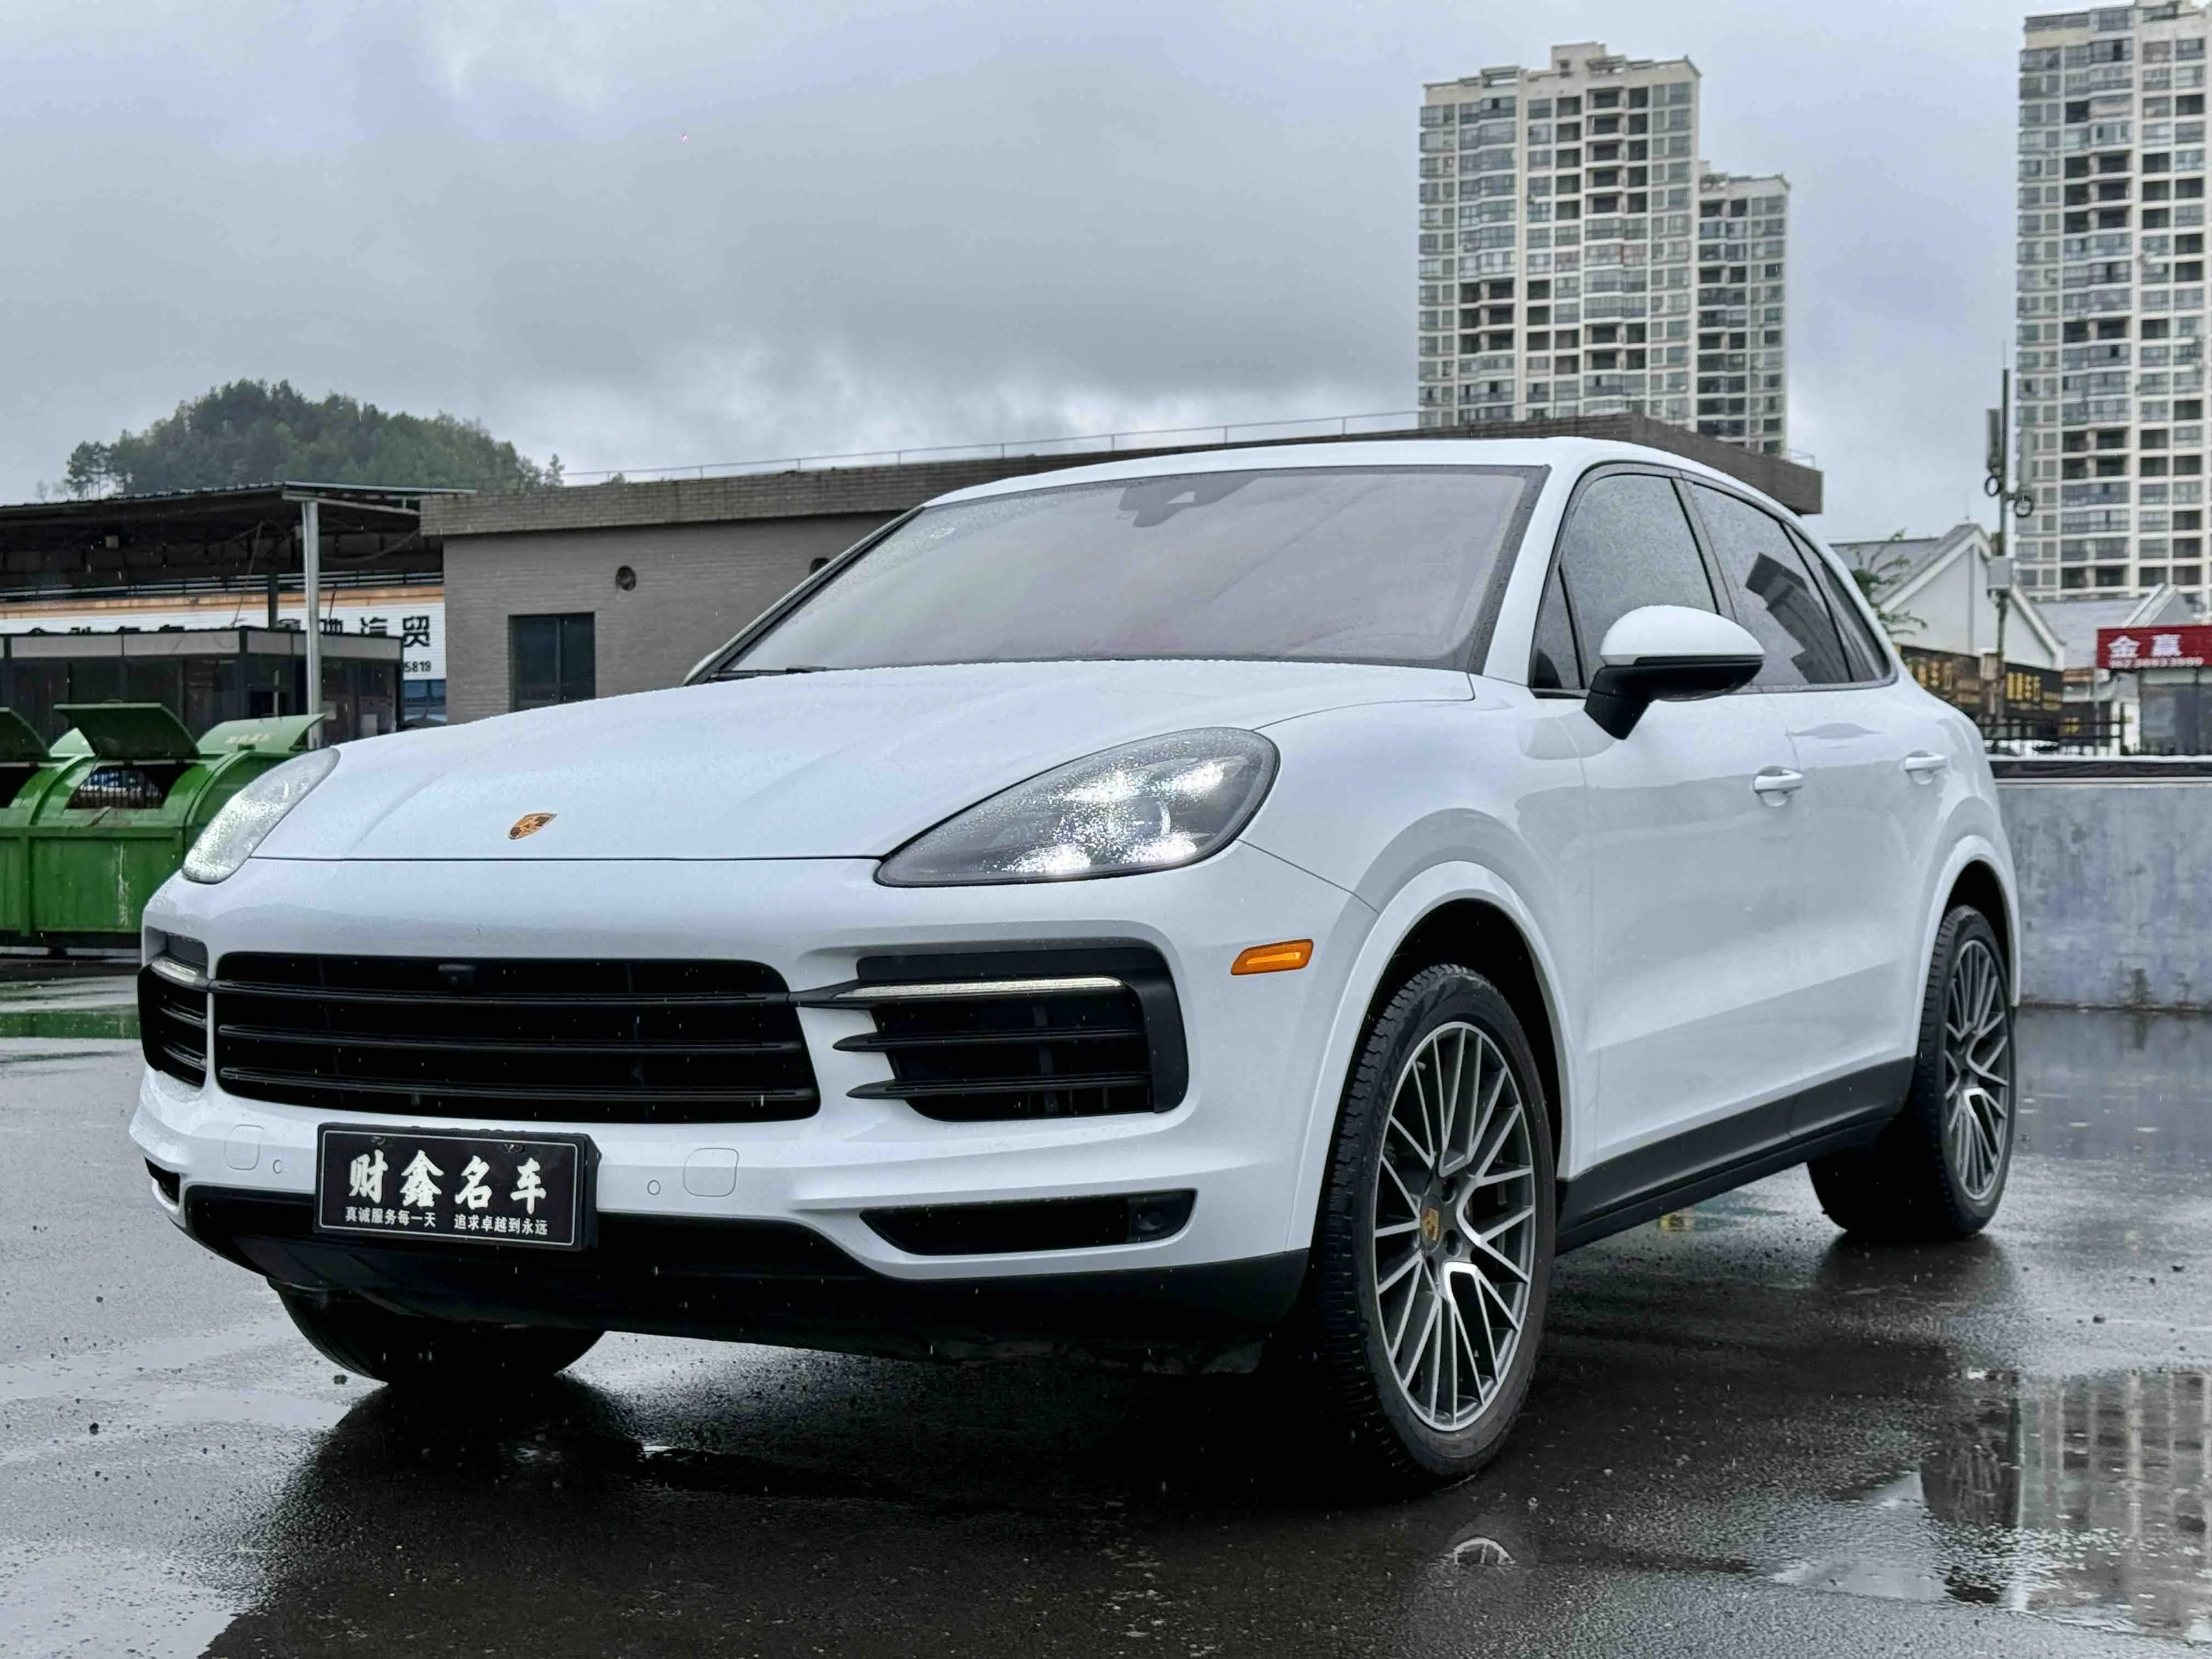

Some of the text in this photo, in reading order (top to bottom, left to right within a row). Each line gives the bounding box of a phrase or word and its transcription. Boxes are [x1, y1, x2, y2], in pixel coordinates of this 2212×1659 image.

[348, 1149, 548, 1215] 财鑫名车
[345, 1206, 548, 1235] 真诚服务每一天 追求卓越到永远
